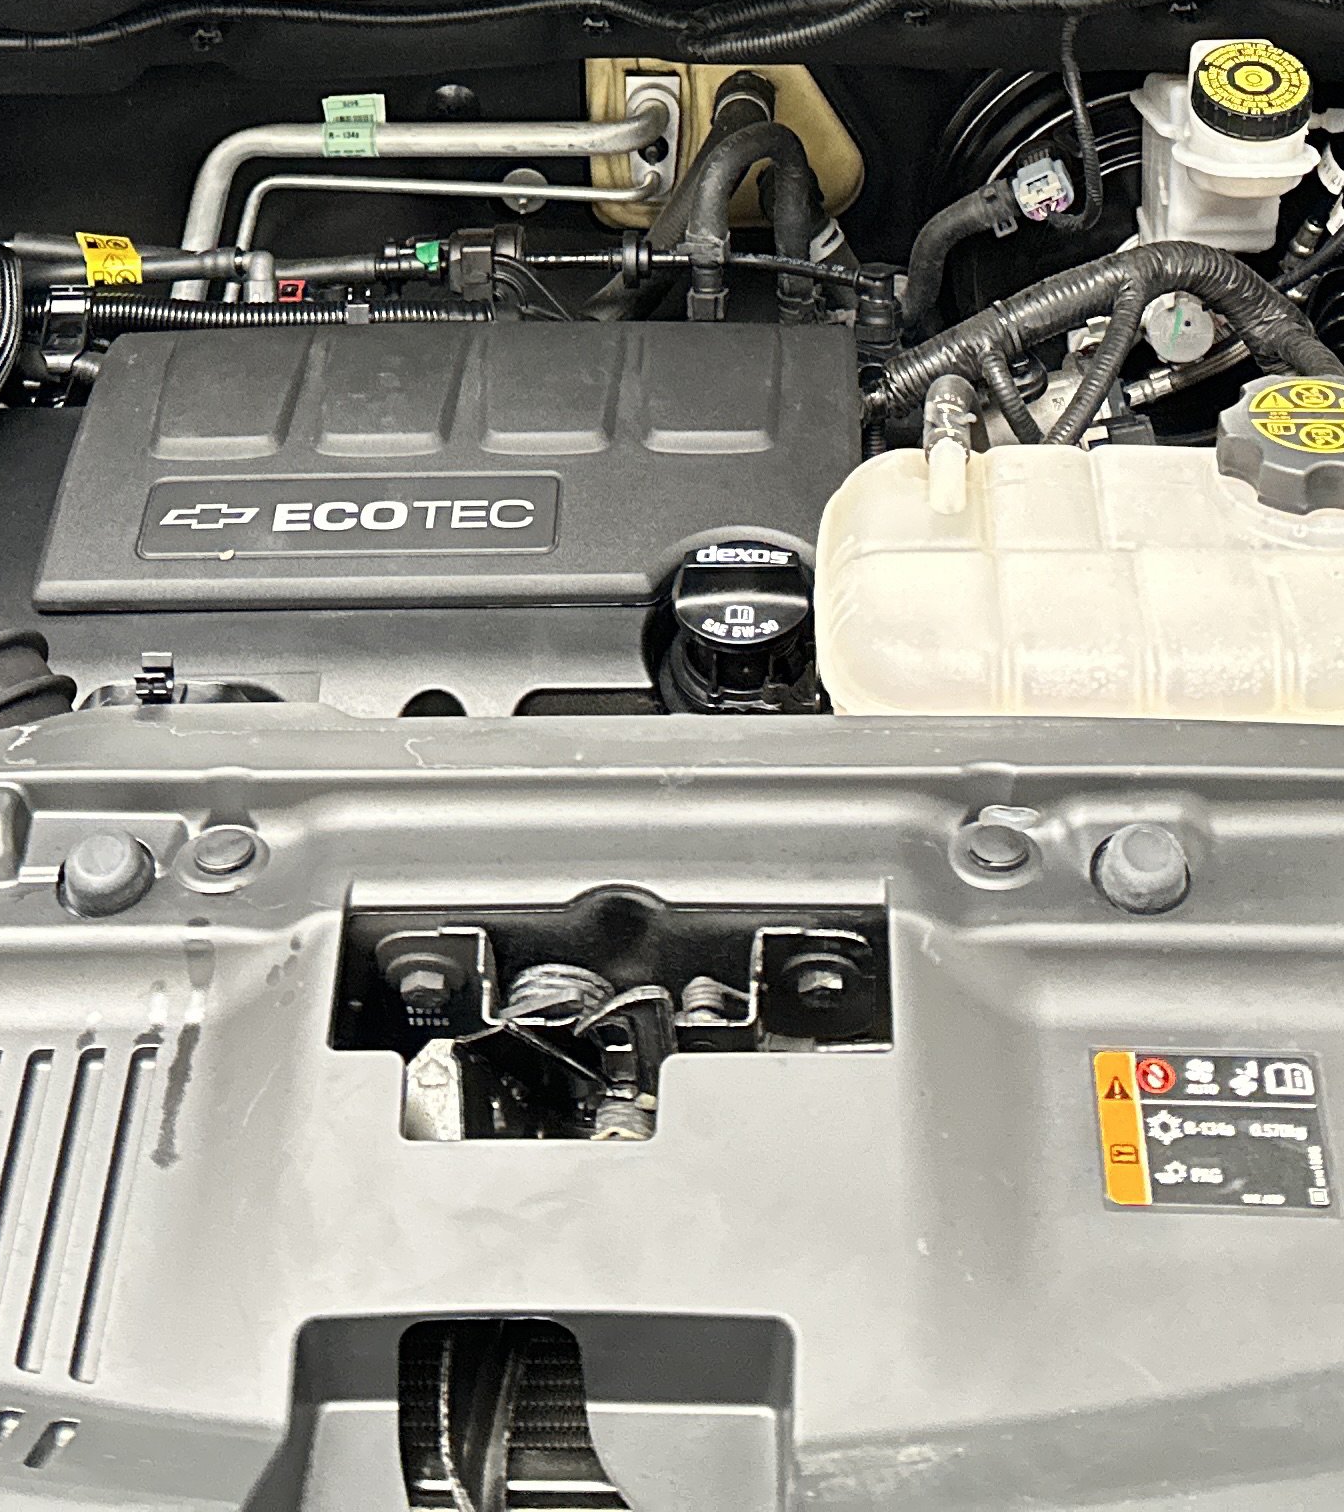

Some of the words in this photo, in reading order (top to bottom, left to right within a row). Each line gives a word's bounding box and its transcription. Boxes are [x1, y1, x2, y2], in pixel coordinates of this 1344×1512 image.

[272, 499, 536, 532] ECOTEC
[696, 546, 791, 565] dexos
[701, 618, 729, 637] SAE
[731, 619, 780, 638] 5W-30
